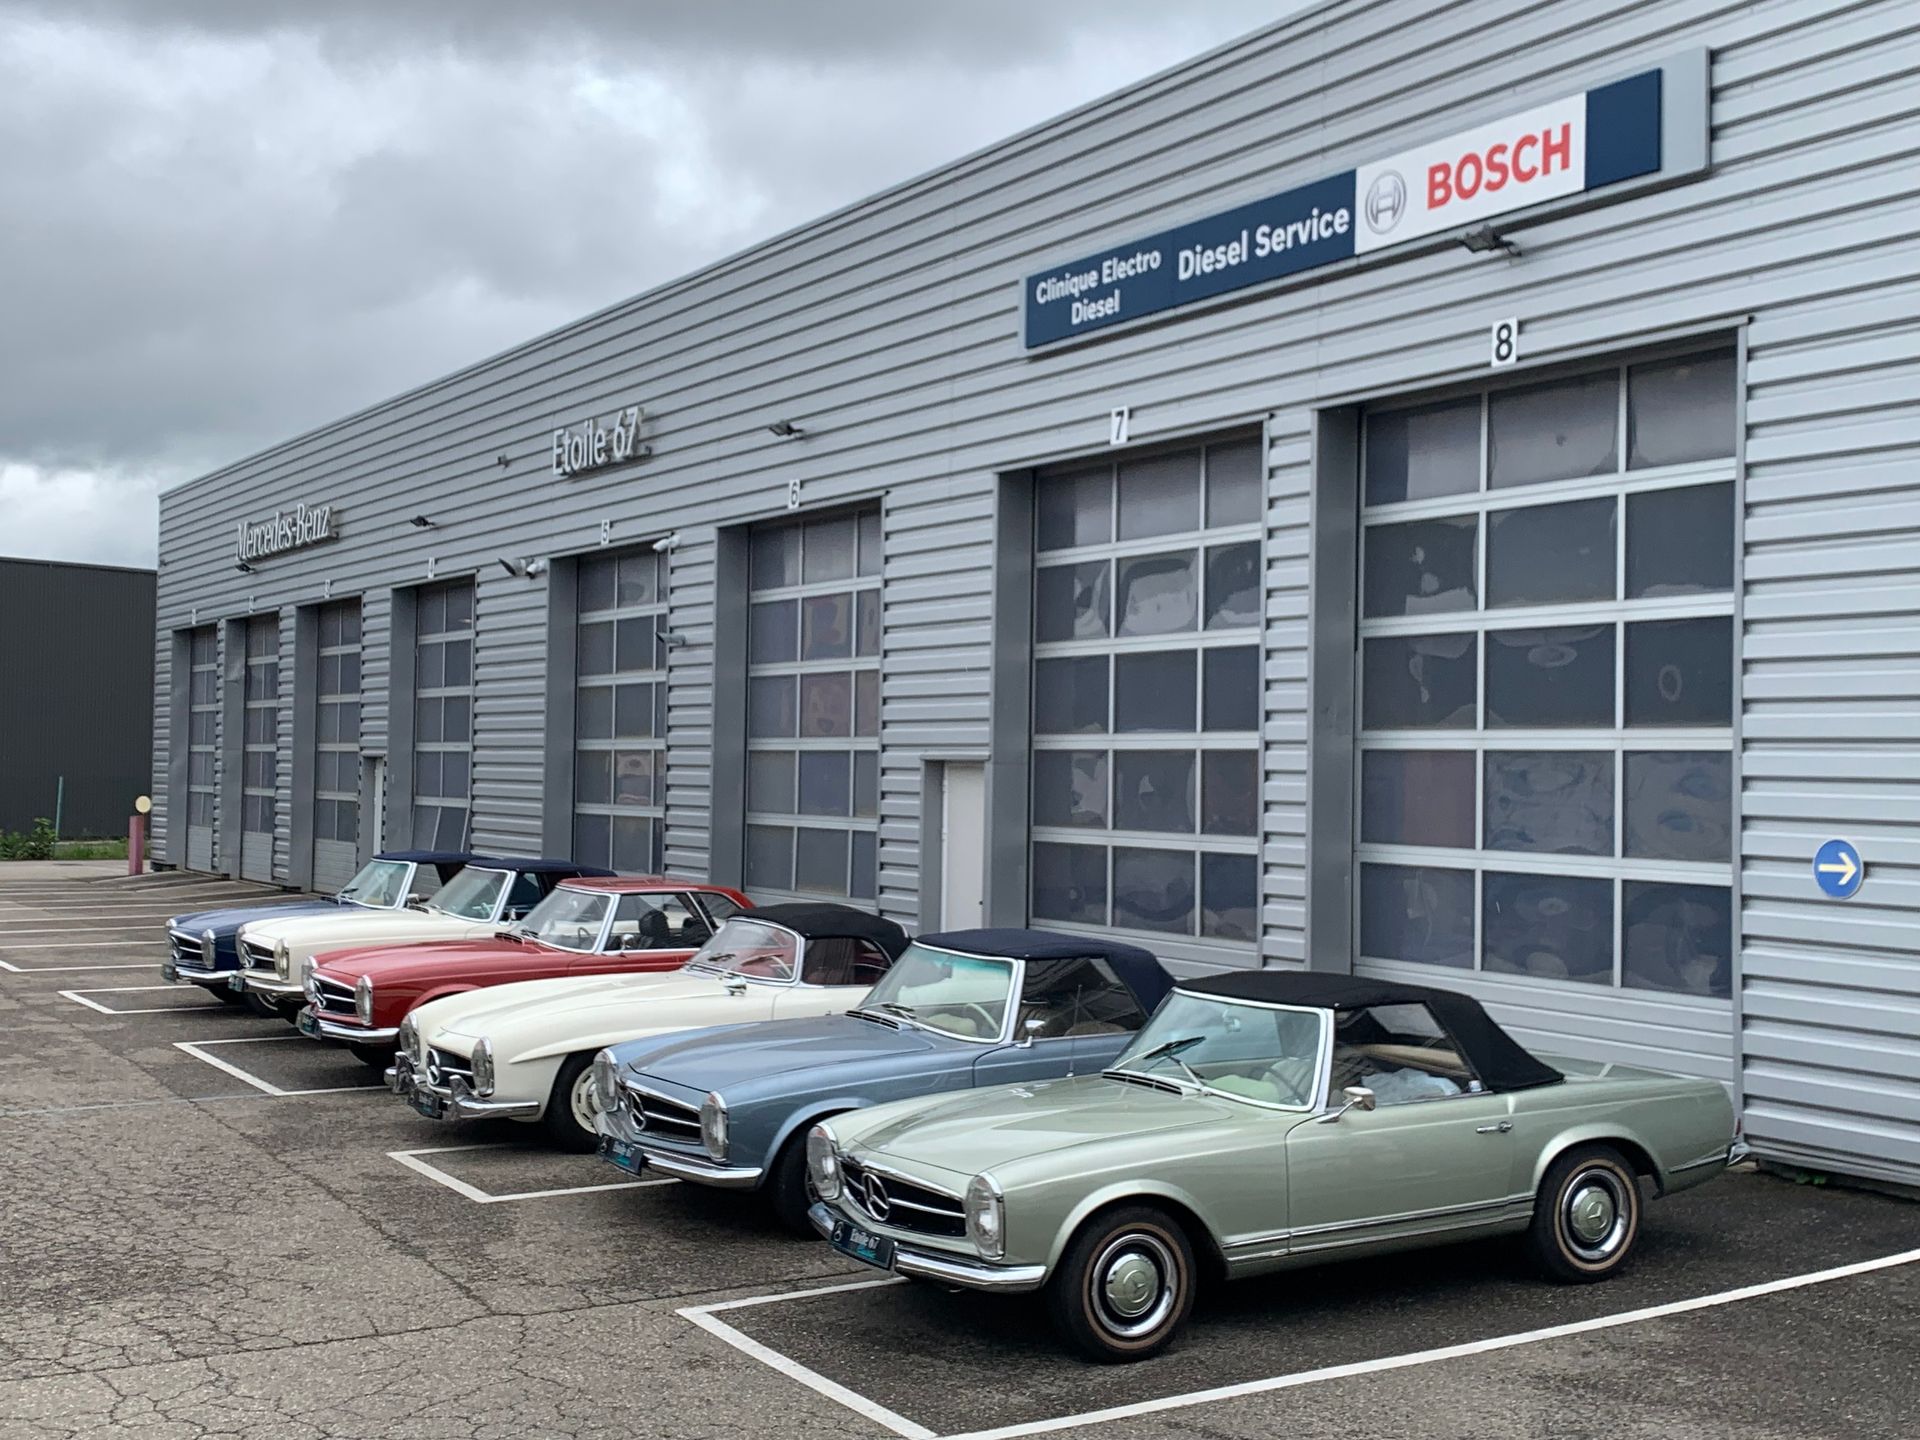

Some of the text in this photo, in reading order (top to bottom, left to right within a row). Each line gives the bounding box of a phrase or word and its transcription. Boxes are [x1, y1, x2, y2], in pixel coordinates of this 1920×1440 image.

[1427, 122, 1571, 211] BOSCH
[1178, 207, 1350, 281] Diesel Service
[1035, 250, 1162, 304] Clinique Electro
[1071, 288, 1121, 325] Diesel
[1495, 323, 1513, 361] 8
[553, 406, 639, 475] Etoile 67
[1114, 409, 1125, 441] 7
[790, 481, 798, 506] 6
[236, 503, 330, 561] Mercedes-Benz
[602, 520, 609, 542] 5
